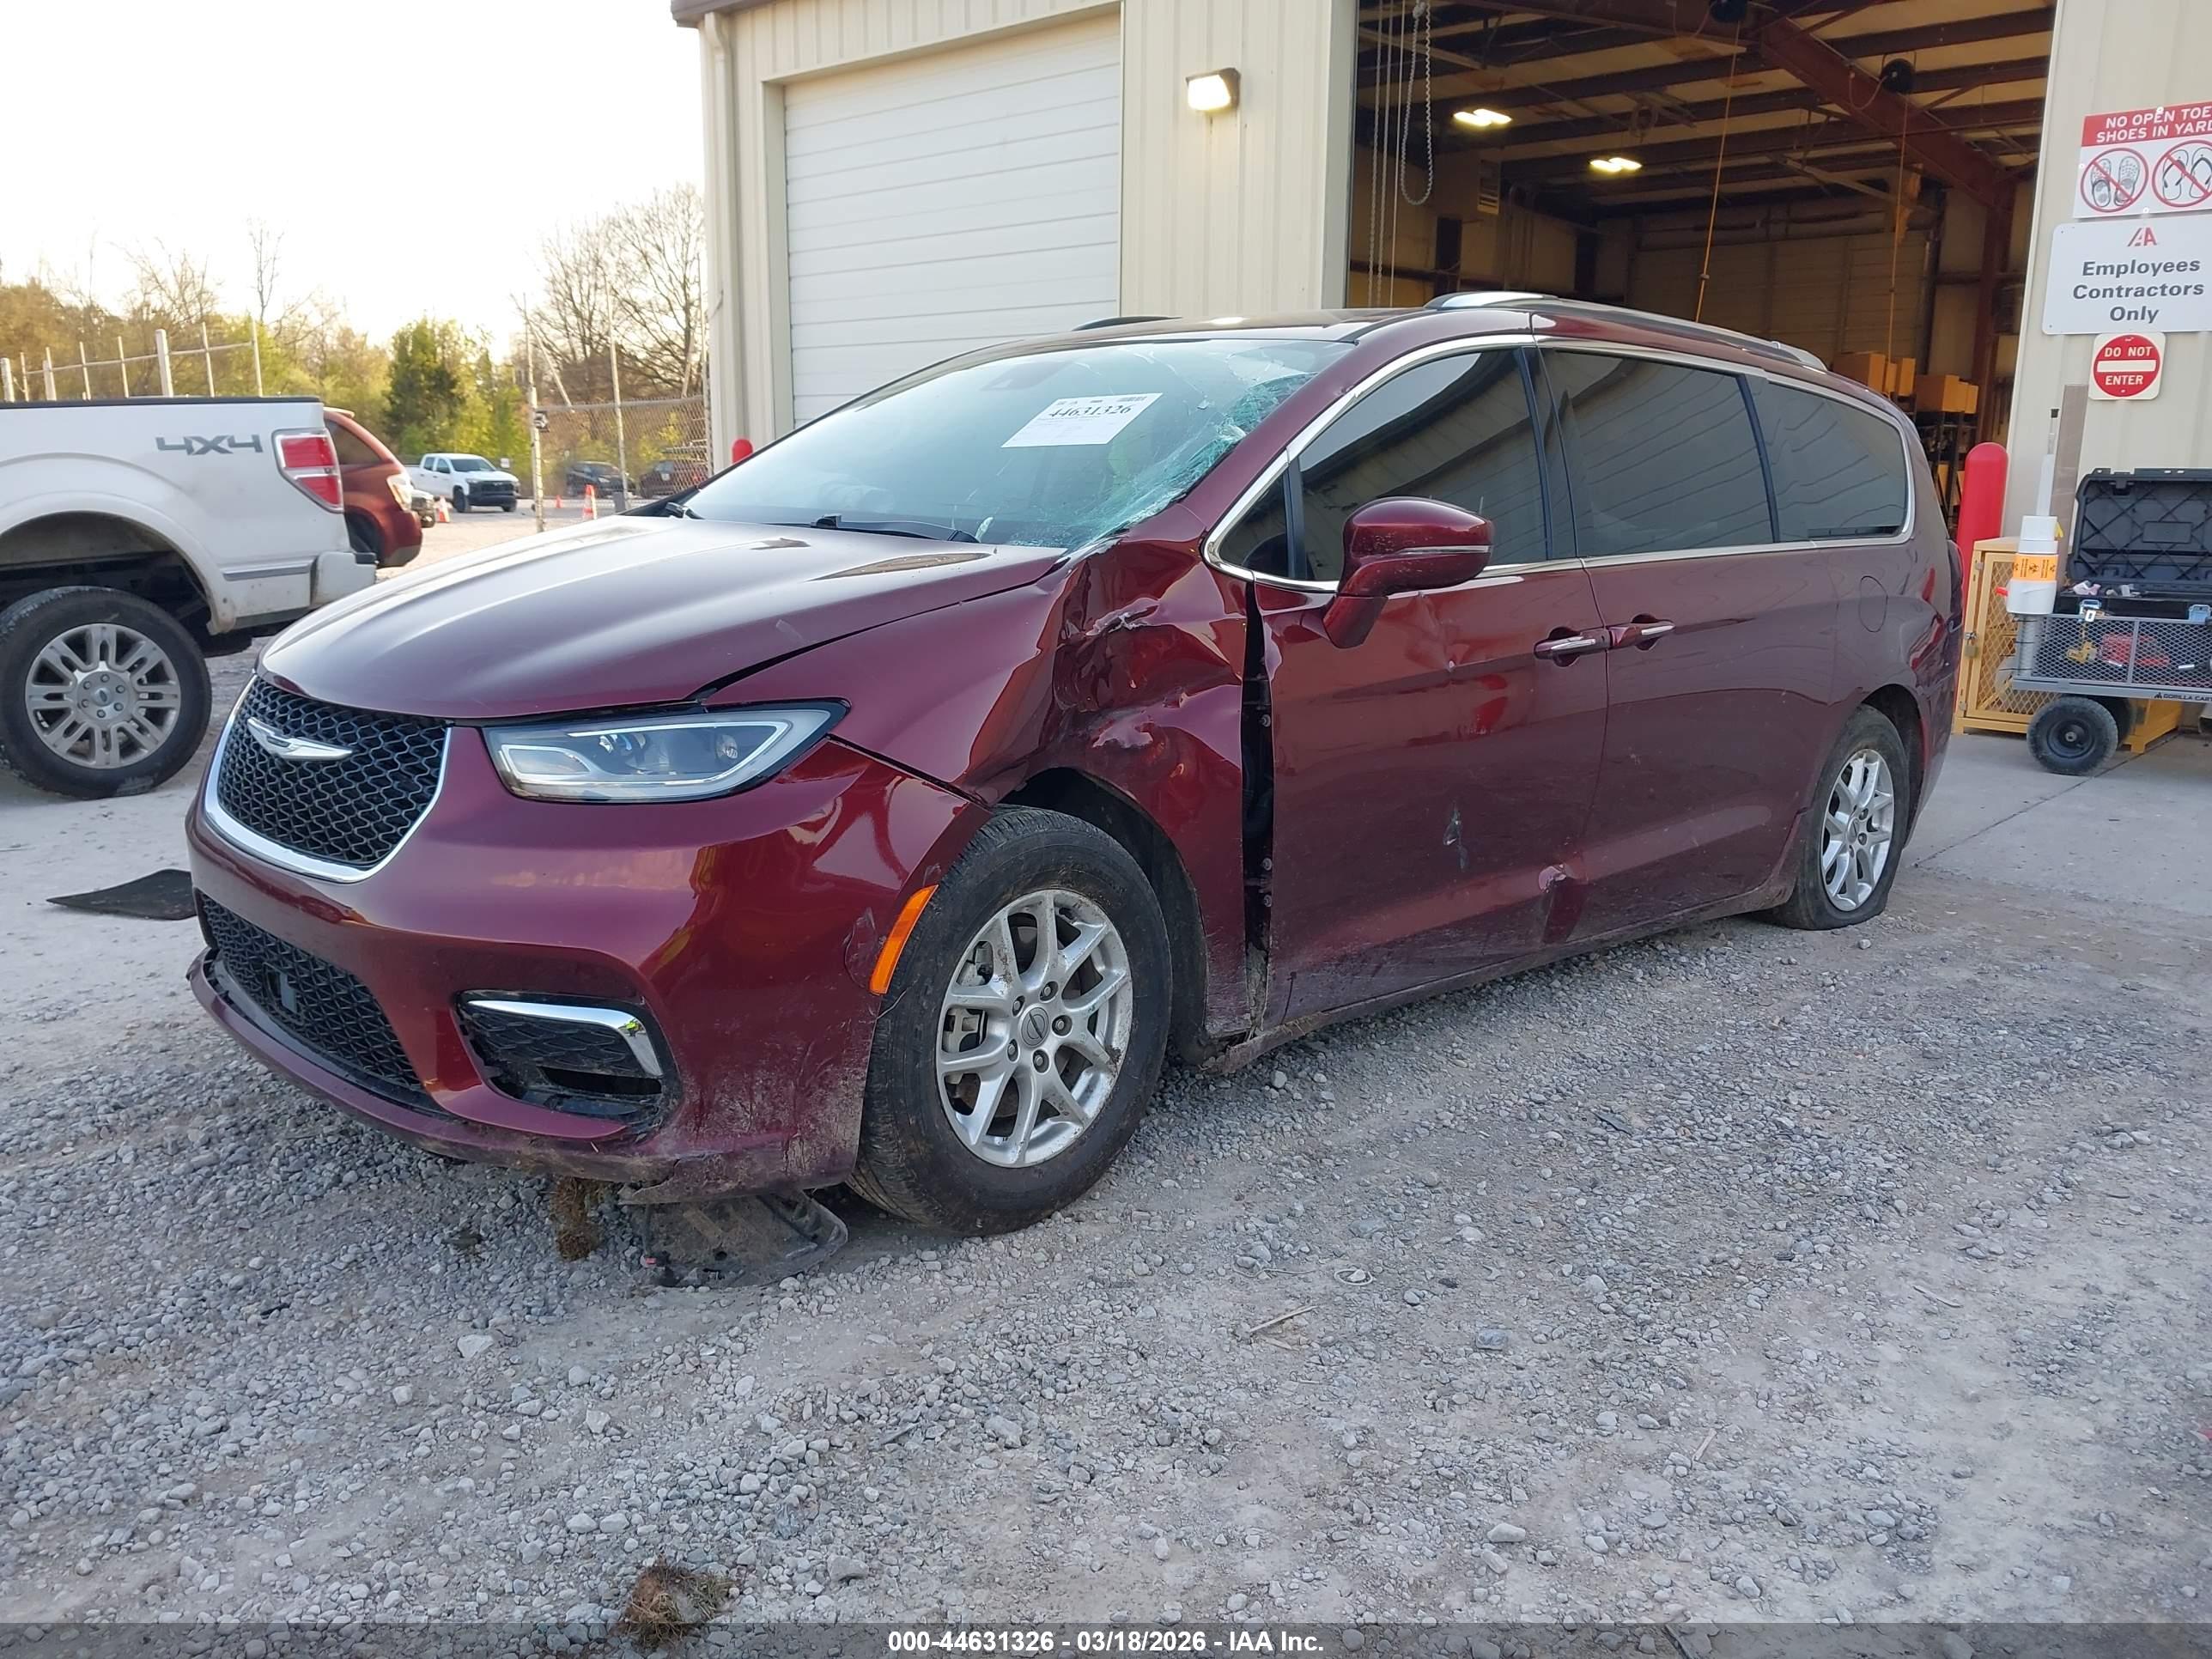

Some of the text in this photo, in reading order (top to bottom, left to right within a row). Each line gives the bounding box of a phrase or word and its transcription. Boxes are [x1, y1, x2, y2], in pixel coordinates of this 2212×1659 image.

[2106, 106, 2212, 129] NO OPEN TOE
[2096, 127, 2148, 143] SHOES
[2152, 125, 2169, 137] IN
[2082, 259, 2201, 278] Employees
[2073, 283, 2205, 300] Contractors
[2109, 306, 2160, 324] Only
[2104, 346, 2154, 357] DO NOT
[2105, 374, 2144, 386] ENTER
[1048, 404, 1134, 417] 44631326
